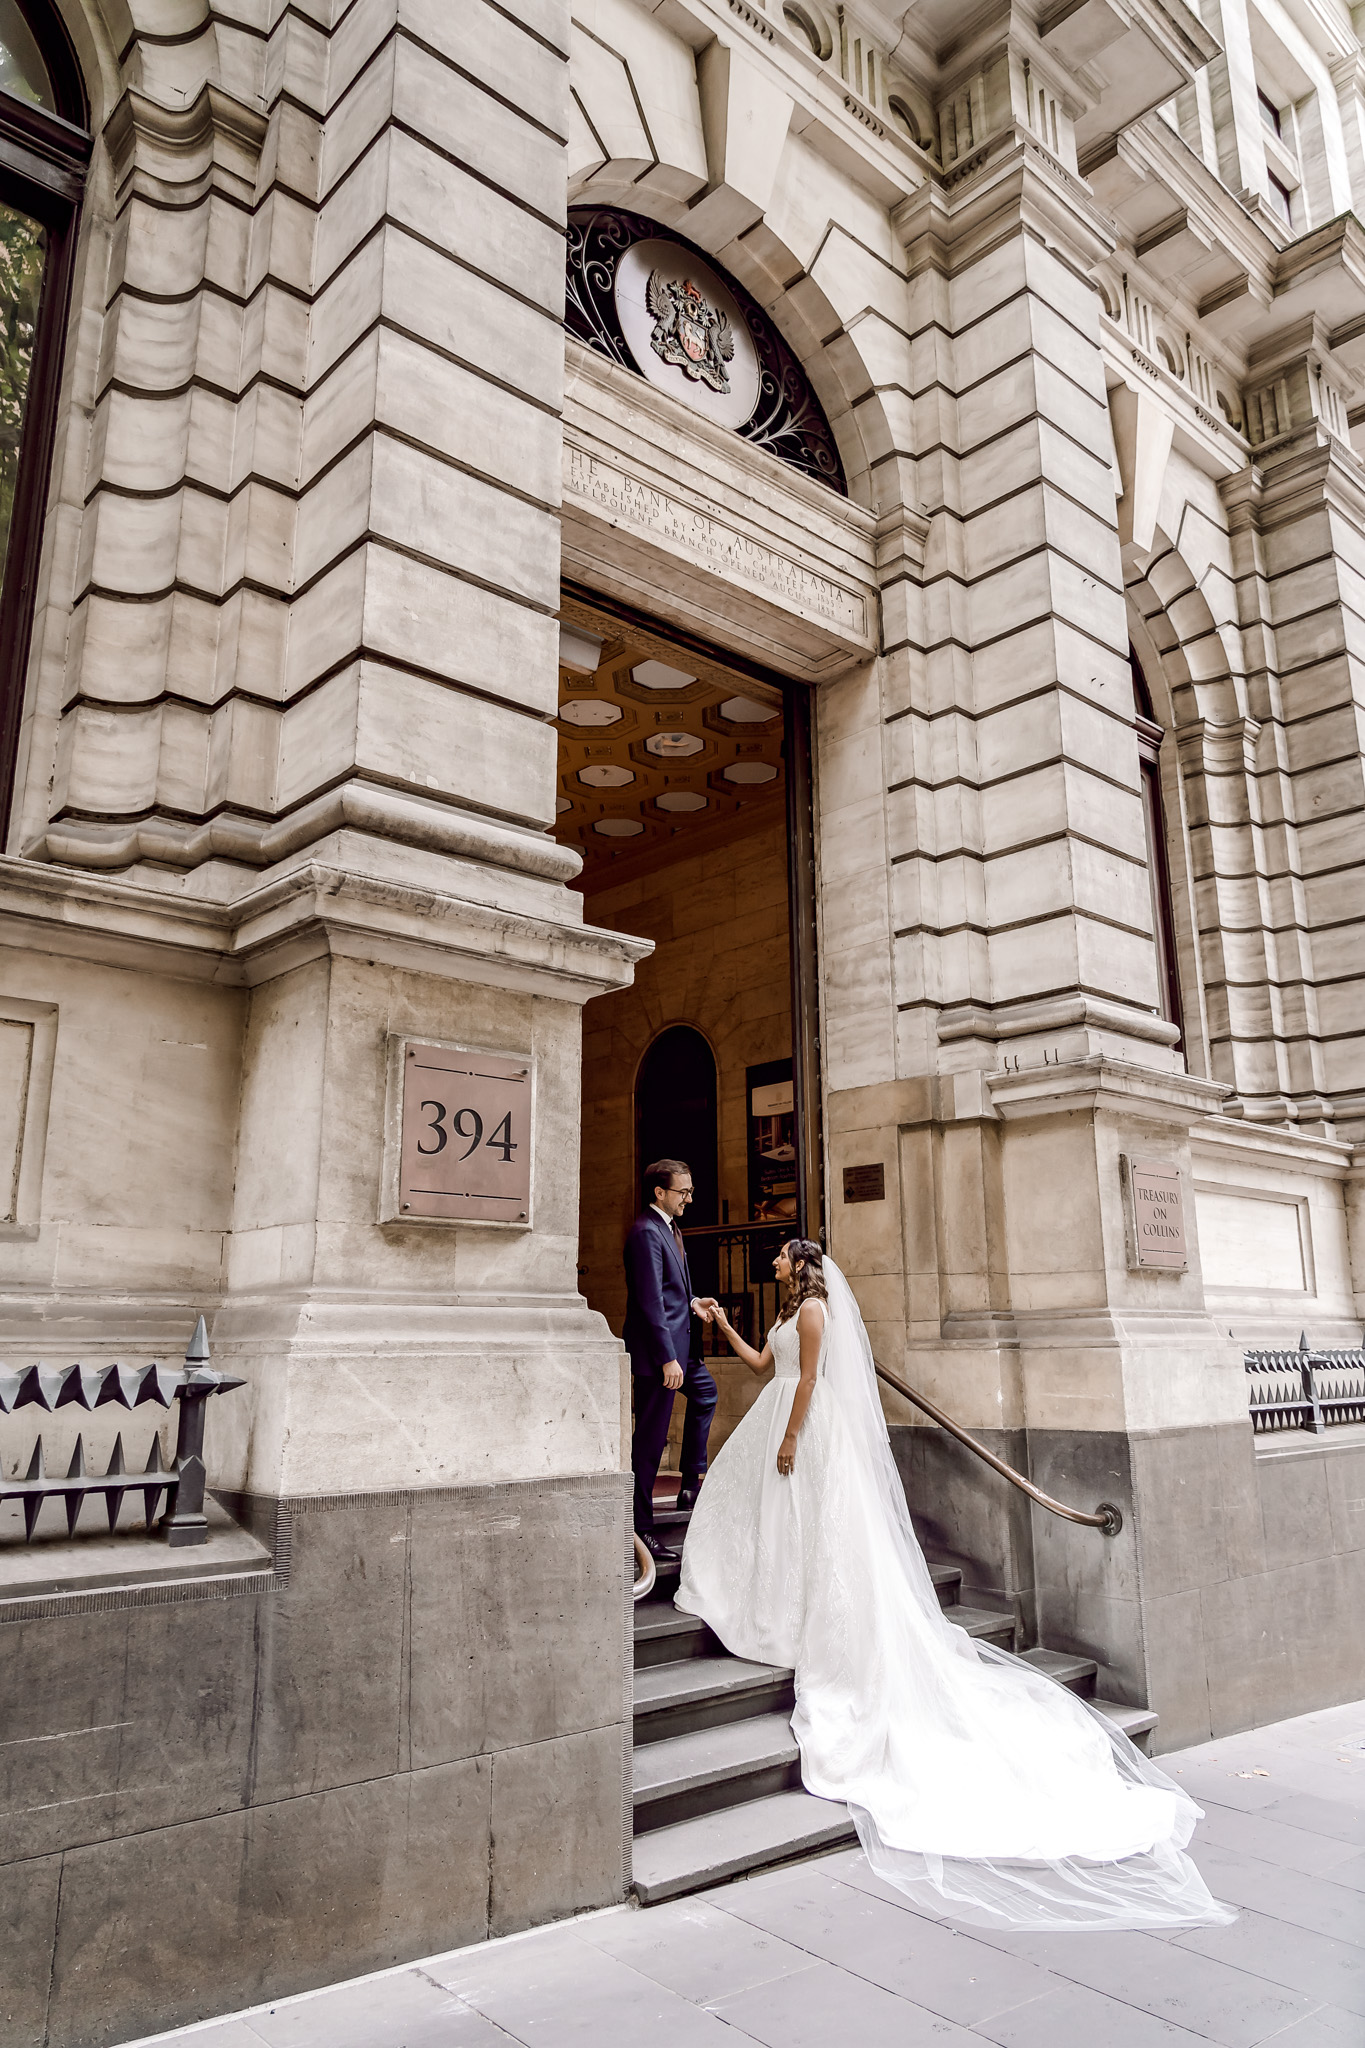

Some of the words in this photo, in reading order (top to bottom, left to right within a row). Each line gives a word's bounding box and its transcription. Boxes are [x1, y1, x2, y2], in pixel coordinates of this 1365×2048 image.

[571, 450, 598, 476] HE
[624, 477, 674, 515] BANK
[693, 515, 715, 535] OF
[734, 537, 843, 603] AUSTRALASIA
[571, 466, 660, 518] ESTABLISHED
[673, 519, 687, 532] BY
[701, 533, 740, 559] ROYAL
[752, 560, 806, 593] CHARTER
[571, 479, 653, 526] MELBOURNE
[664, 525, 713, 556] BRANCH
[721, 554, 765, 581] OPENED
[773, 581, 811, 605] AUGUST
[417, 1100, 518, 1163] 394
[1137, 1188, 1179, 1205] TREASURY
[1153, 1207, 1167, 1220] ON
[1143, 1224, 1180, 1238] COLLINS
